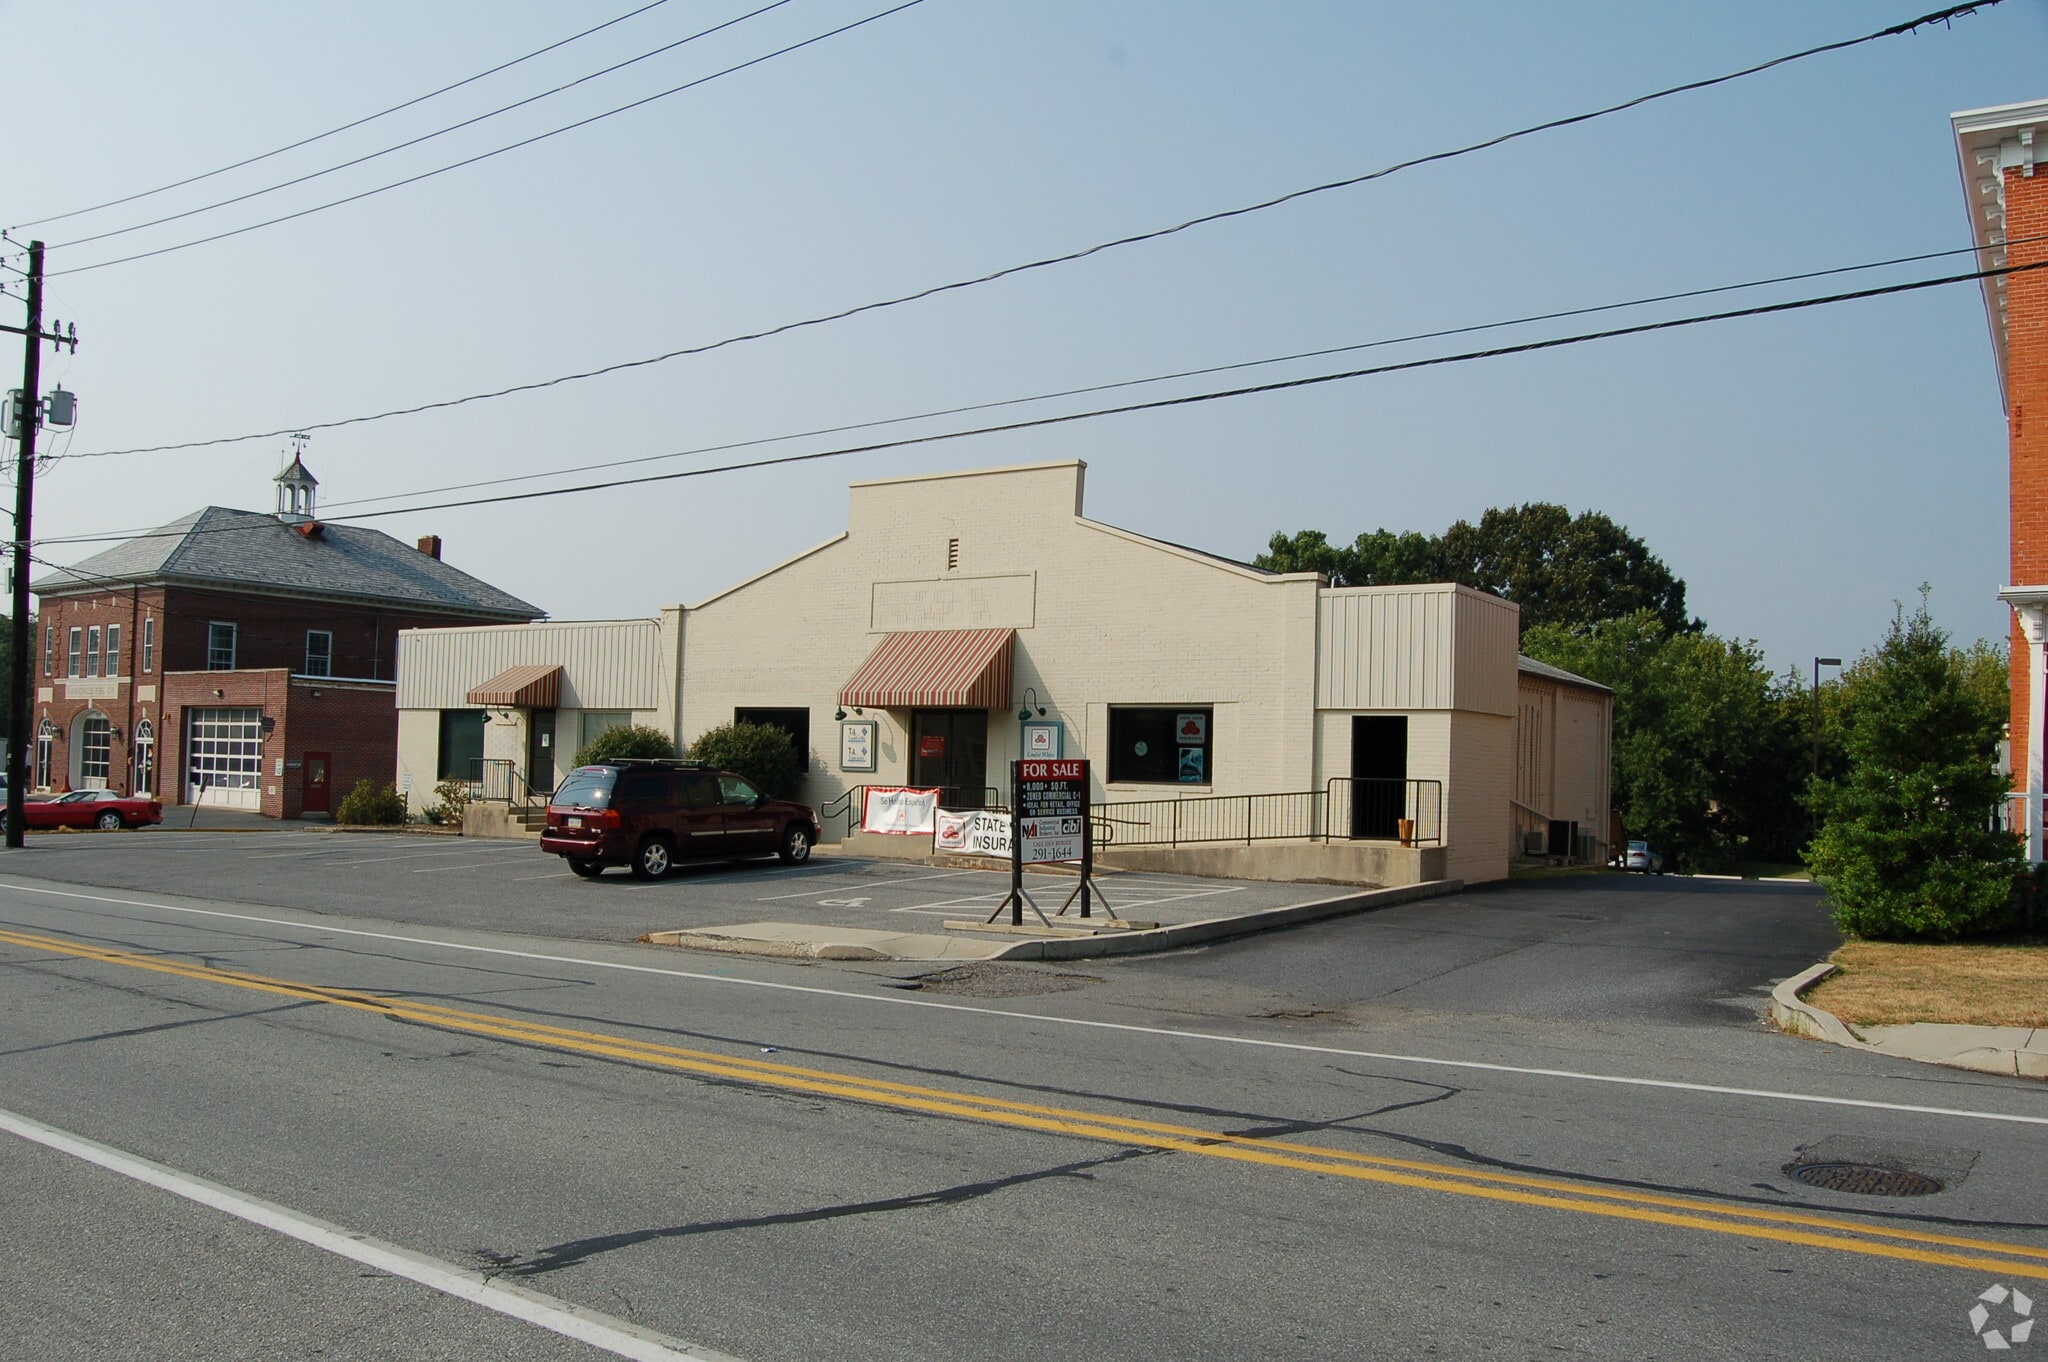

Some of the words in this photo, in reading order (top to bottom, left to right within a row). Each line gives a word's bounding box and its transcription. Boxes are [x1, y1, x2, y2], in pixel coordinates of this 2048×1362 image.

[1023, 763, 1047, 777] FOR
[1052, 763, 1079, 776] SALE
[1026, 791, 1042, 801] ZONED
[1042, 791, 1072, 801] COMMERCIAL
[1037, 808, 1055, 816] SERVICE
[1056, 807, 1078, 815] BUSINESS
[974, 817, 1006, 833] STATE
[1022, 819, 1038, 840] NAI
[1032, 846, 1073, 860] 291-1644
